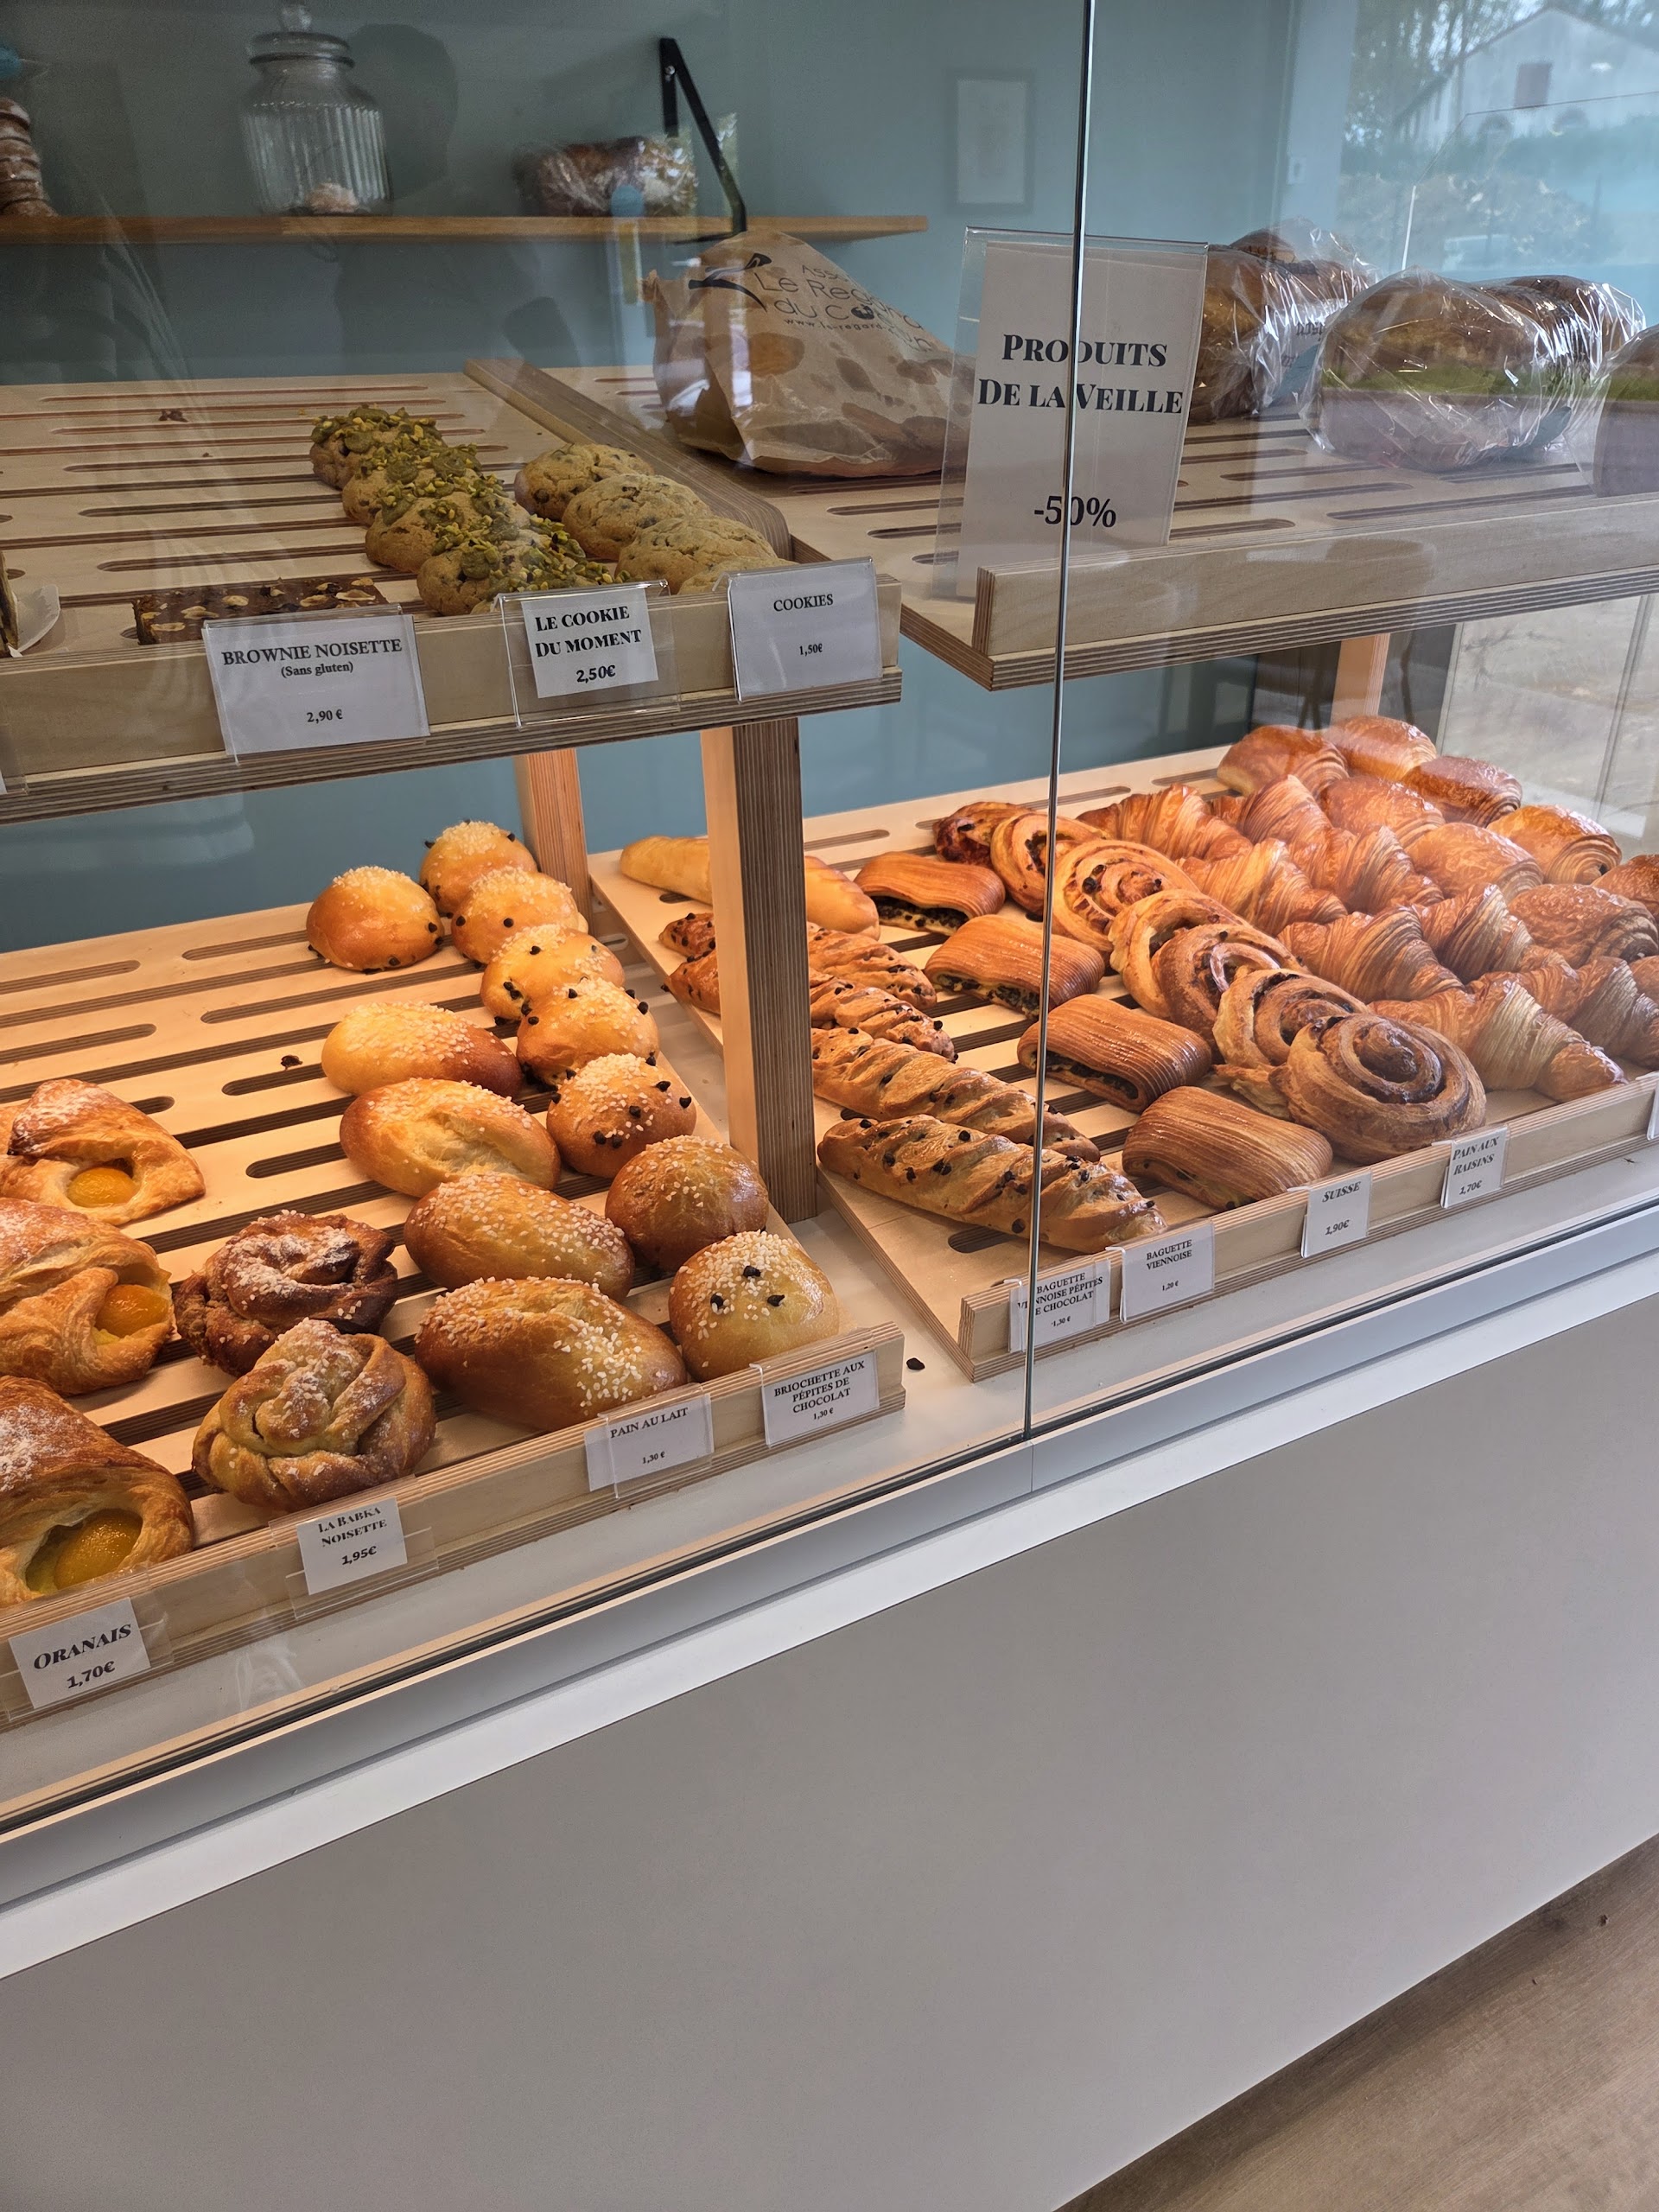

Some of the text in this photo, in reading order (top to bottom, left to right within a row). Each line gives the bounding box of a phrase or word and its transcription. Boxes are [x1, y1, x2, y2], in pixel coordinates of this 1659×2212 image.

[754, 272, 799, 293] Le
[1002, 334, 1167, 367] PRODUITS
[1034, 495, 1116, 528] -50%
[773, 594, 834, 612] COOKIES
[535, 606, 630, 632] LE COOKIE
[221, 639, 403, 666] BROWNIE NOISETTE
[535, 629, 641, 658] DU MOMENT
[799, 644, 823, 658] 1,50€
[281, 661, 353, 678] (Sans gluten)
[575, 664, 616, 684] 2,50€
[306, 709, 343, 725] 2,90 €
[1452, 1136, 1499, 1160] PAIN AUX
[1453, 1154, 1495, 1175] RAISINS
[1322, 1181, 1361, 1203] SUISSE
[1459, 1179, 1483, 1195] 1,70€
[1325, 1219, 1350, 1236] 1,90€
[1147, 1239, 1192, 1261] BAGUETTE
[1147, 1249, 1192, 1270] VIENNOISE
[1018, 1276, 1103, 1310] VINNOISE PÉPITES
[1036, 1273, 1086, 1294] BAGUETTE
[1043, 1291, 1094, 1313] CHOCOLAT
[774, 1360, 865, 1397] BRIOCHETTE AUX
[792, 1377, 850, 1402] PÉPITES DE
[792, 1388, 851, 1414] CHOCOLAT
[610, 1408, 689, 1439] PAIN AU LAIT
[813, 1409, 828, 1420] 1,30
[642, 1452, 658, 1465] 1,30
[318, 1507, 381, 1533] LA BABKA
[321, 1519, 387, 1548] NOISETTE
[341, 1546, 377, 1566] 1,95€
[34, 1624, 131, 1669] ORANAIS
[67, 1661, 116, 1689] 1,70€
